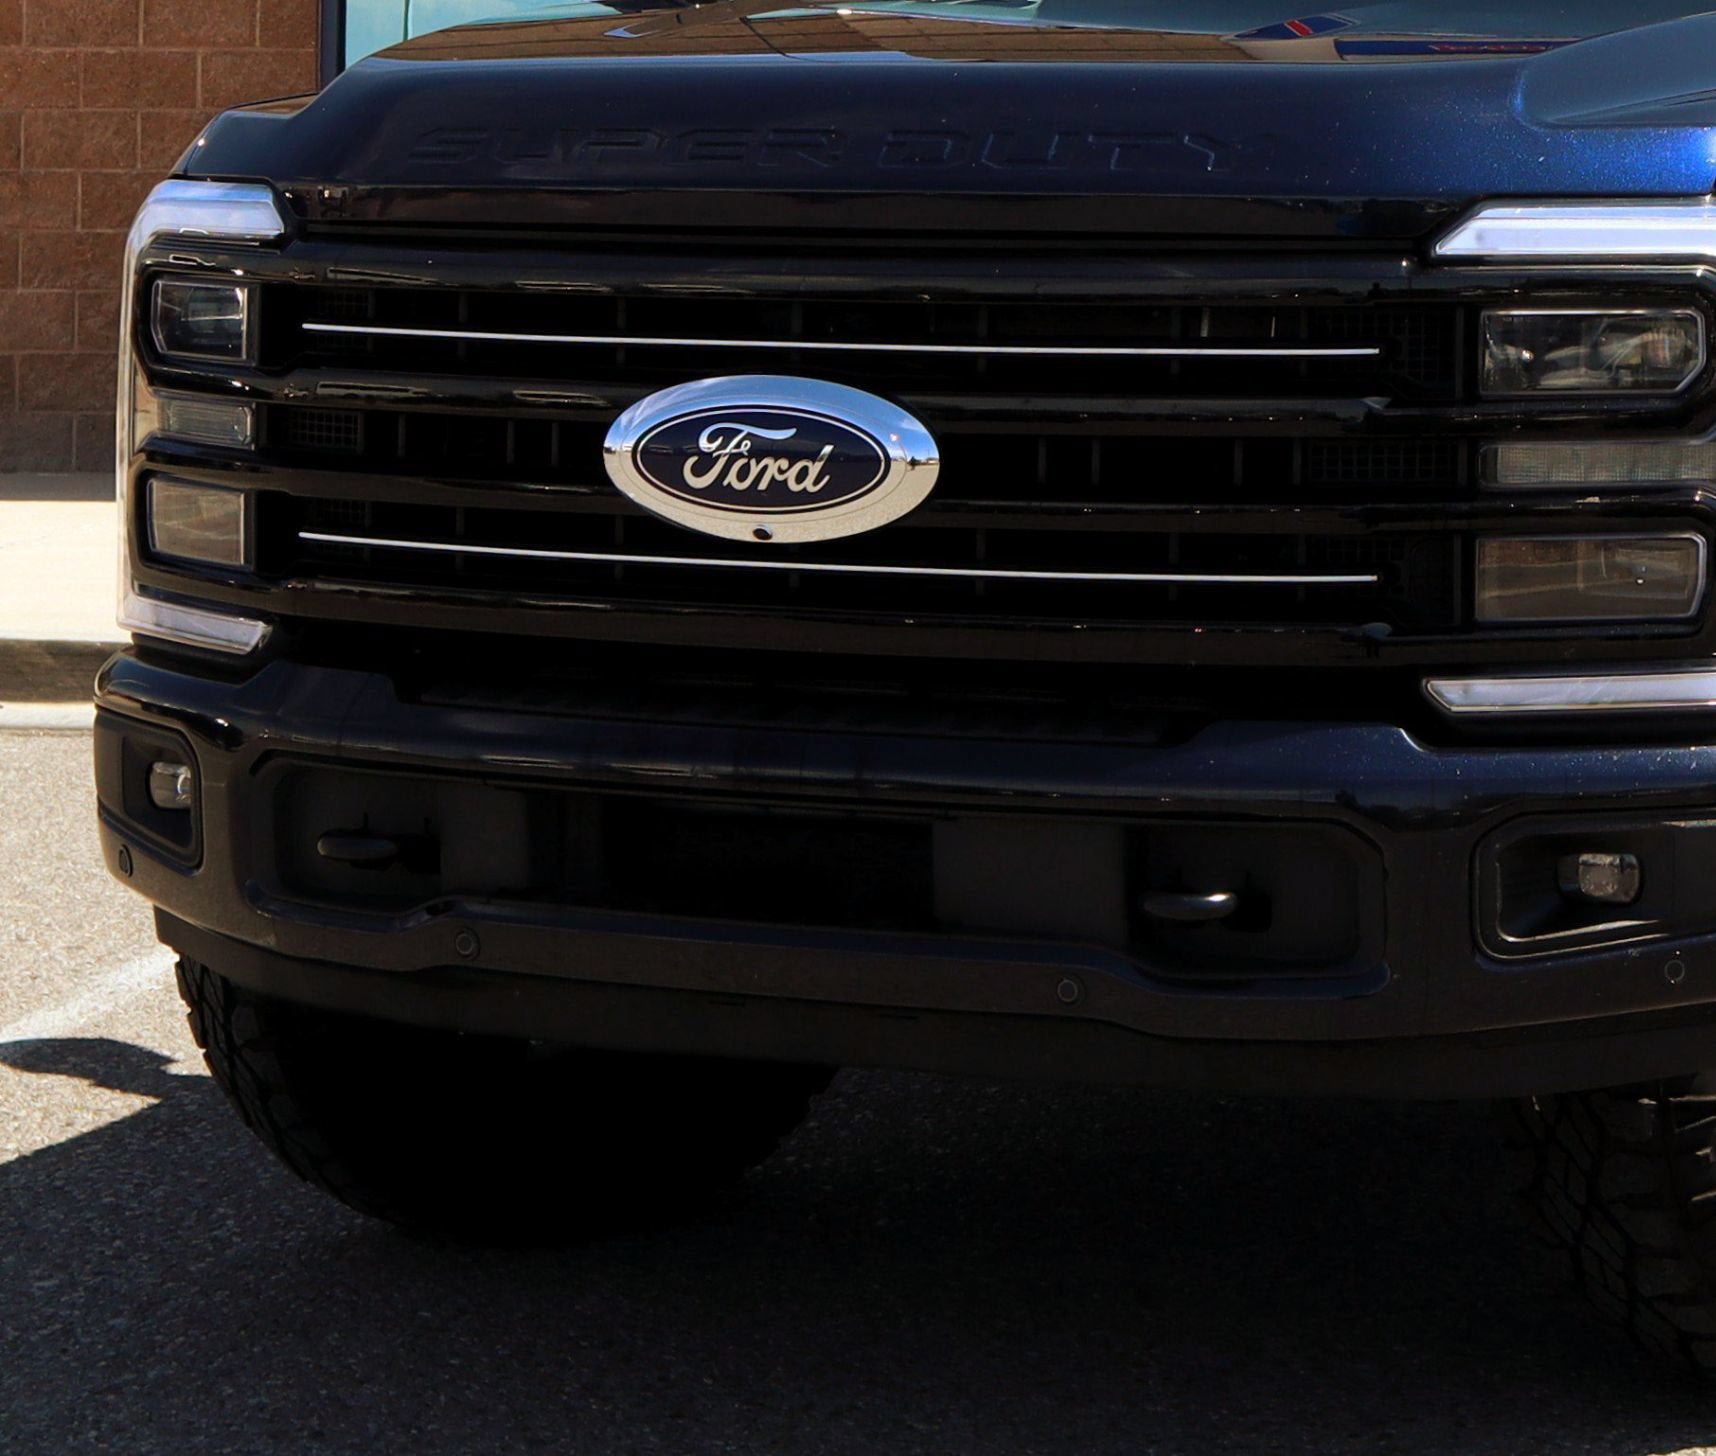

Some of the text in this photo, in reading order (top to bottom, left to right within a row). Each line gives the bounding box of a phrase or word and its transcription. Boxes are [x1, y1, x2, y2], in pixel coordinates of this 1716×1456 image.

[404, 127, 1270, 173] SUPER DUTY
[682, 421, 835, 493] Ford
